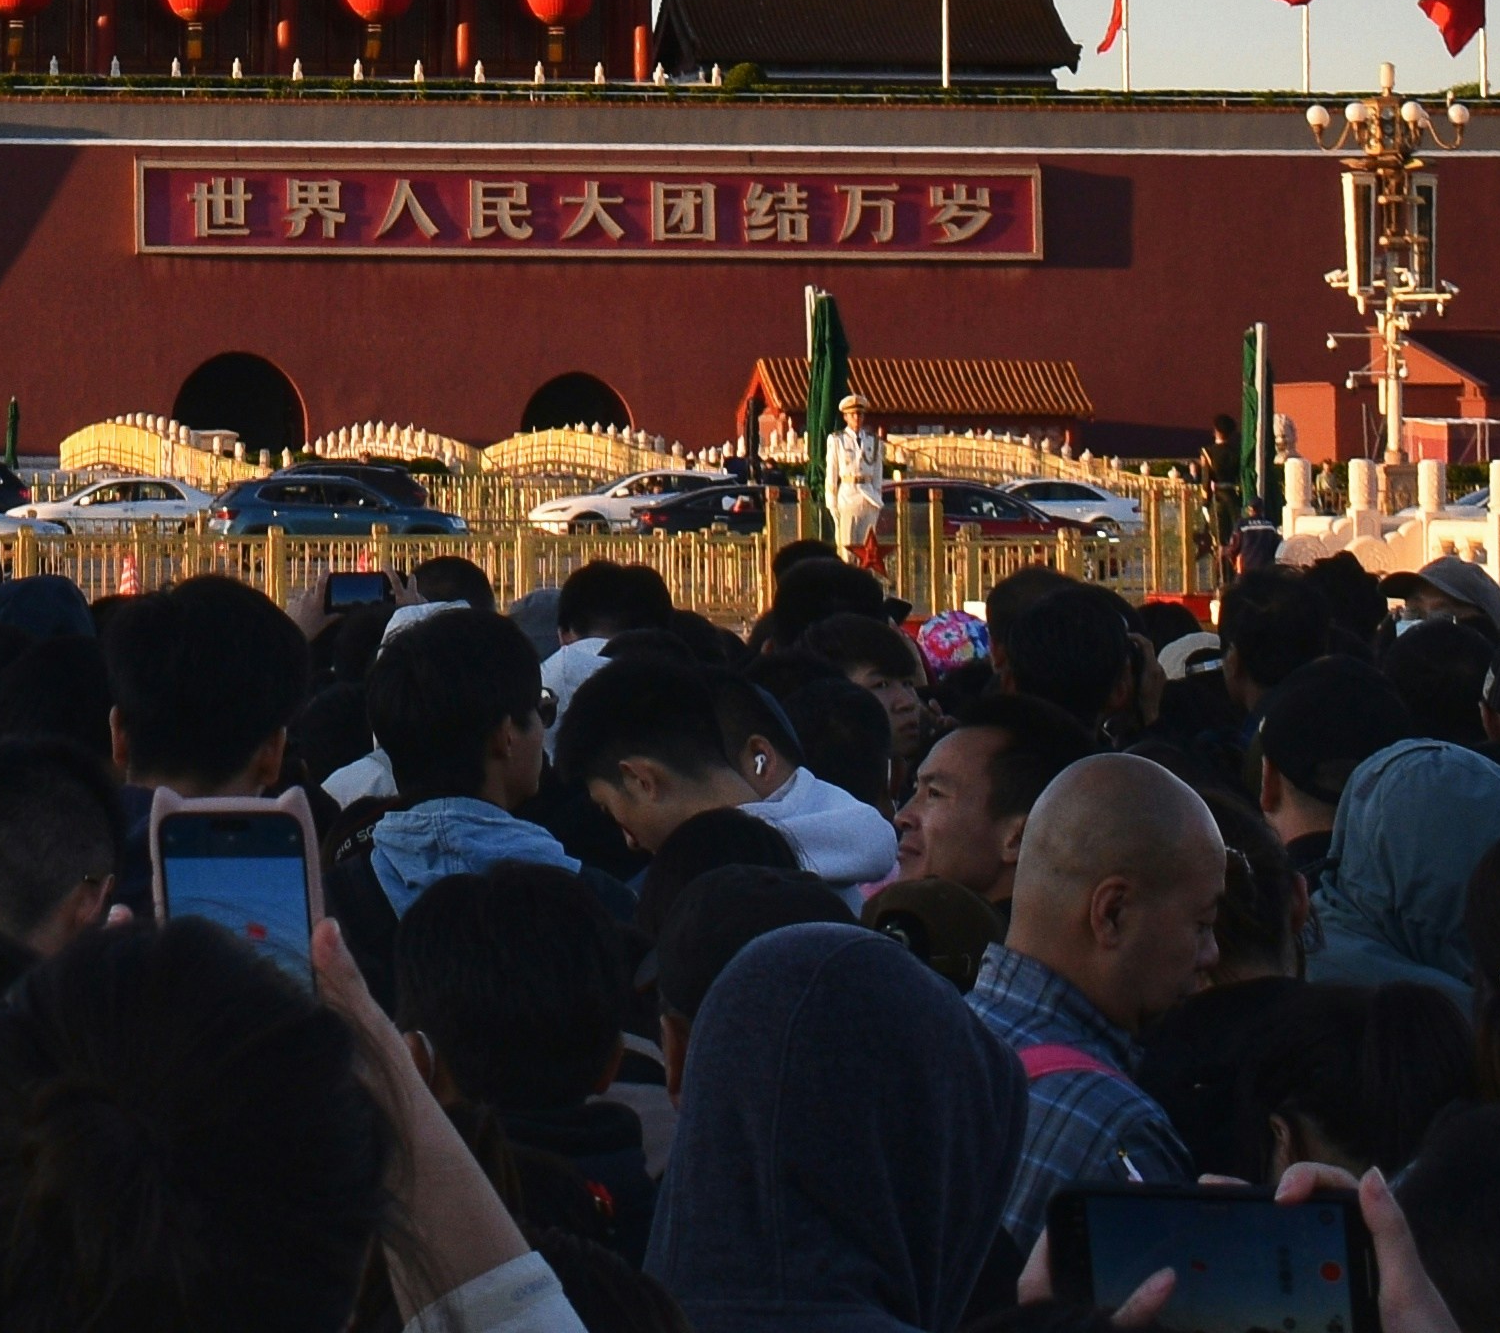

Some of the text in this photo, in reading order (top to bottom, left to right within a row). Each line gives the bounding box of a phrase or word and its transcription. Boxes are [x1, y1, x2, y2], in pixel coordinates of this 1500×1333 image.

[187, 177, 993, 244] 世界人民大团结万岁
